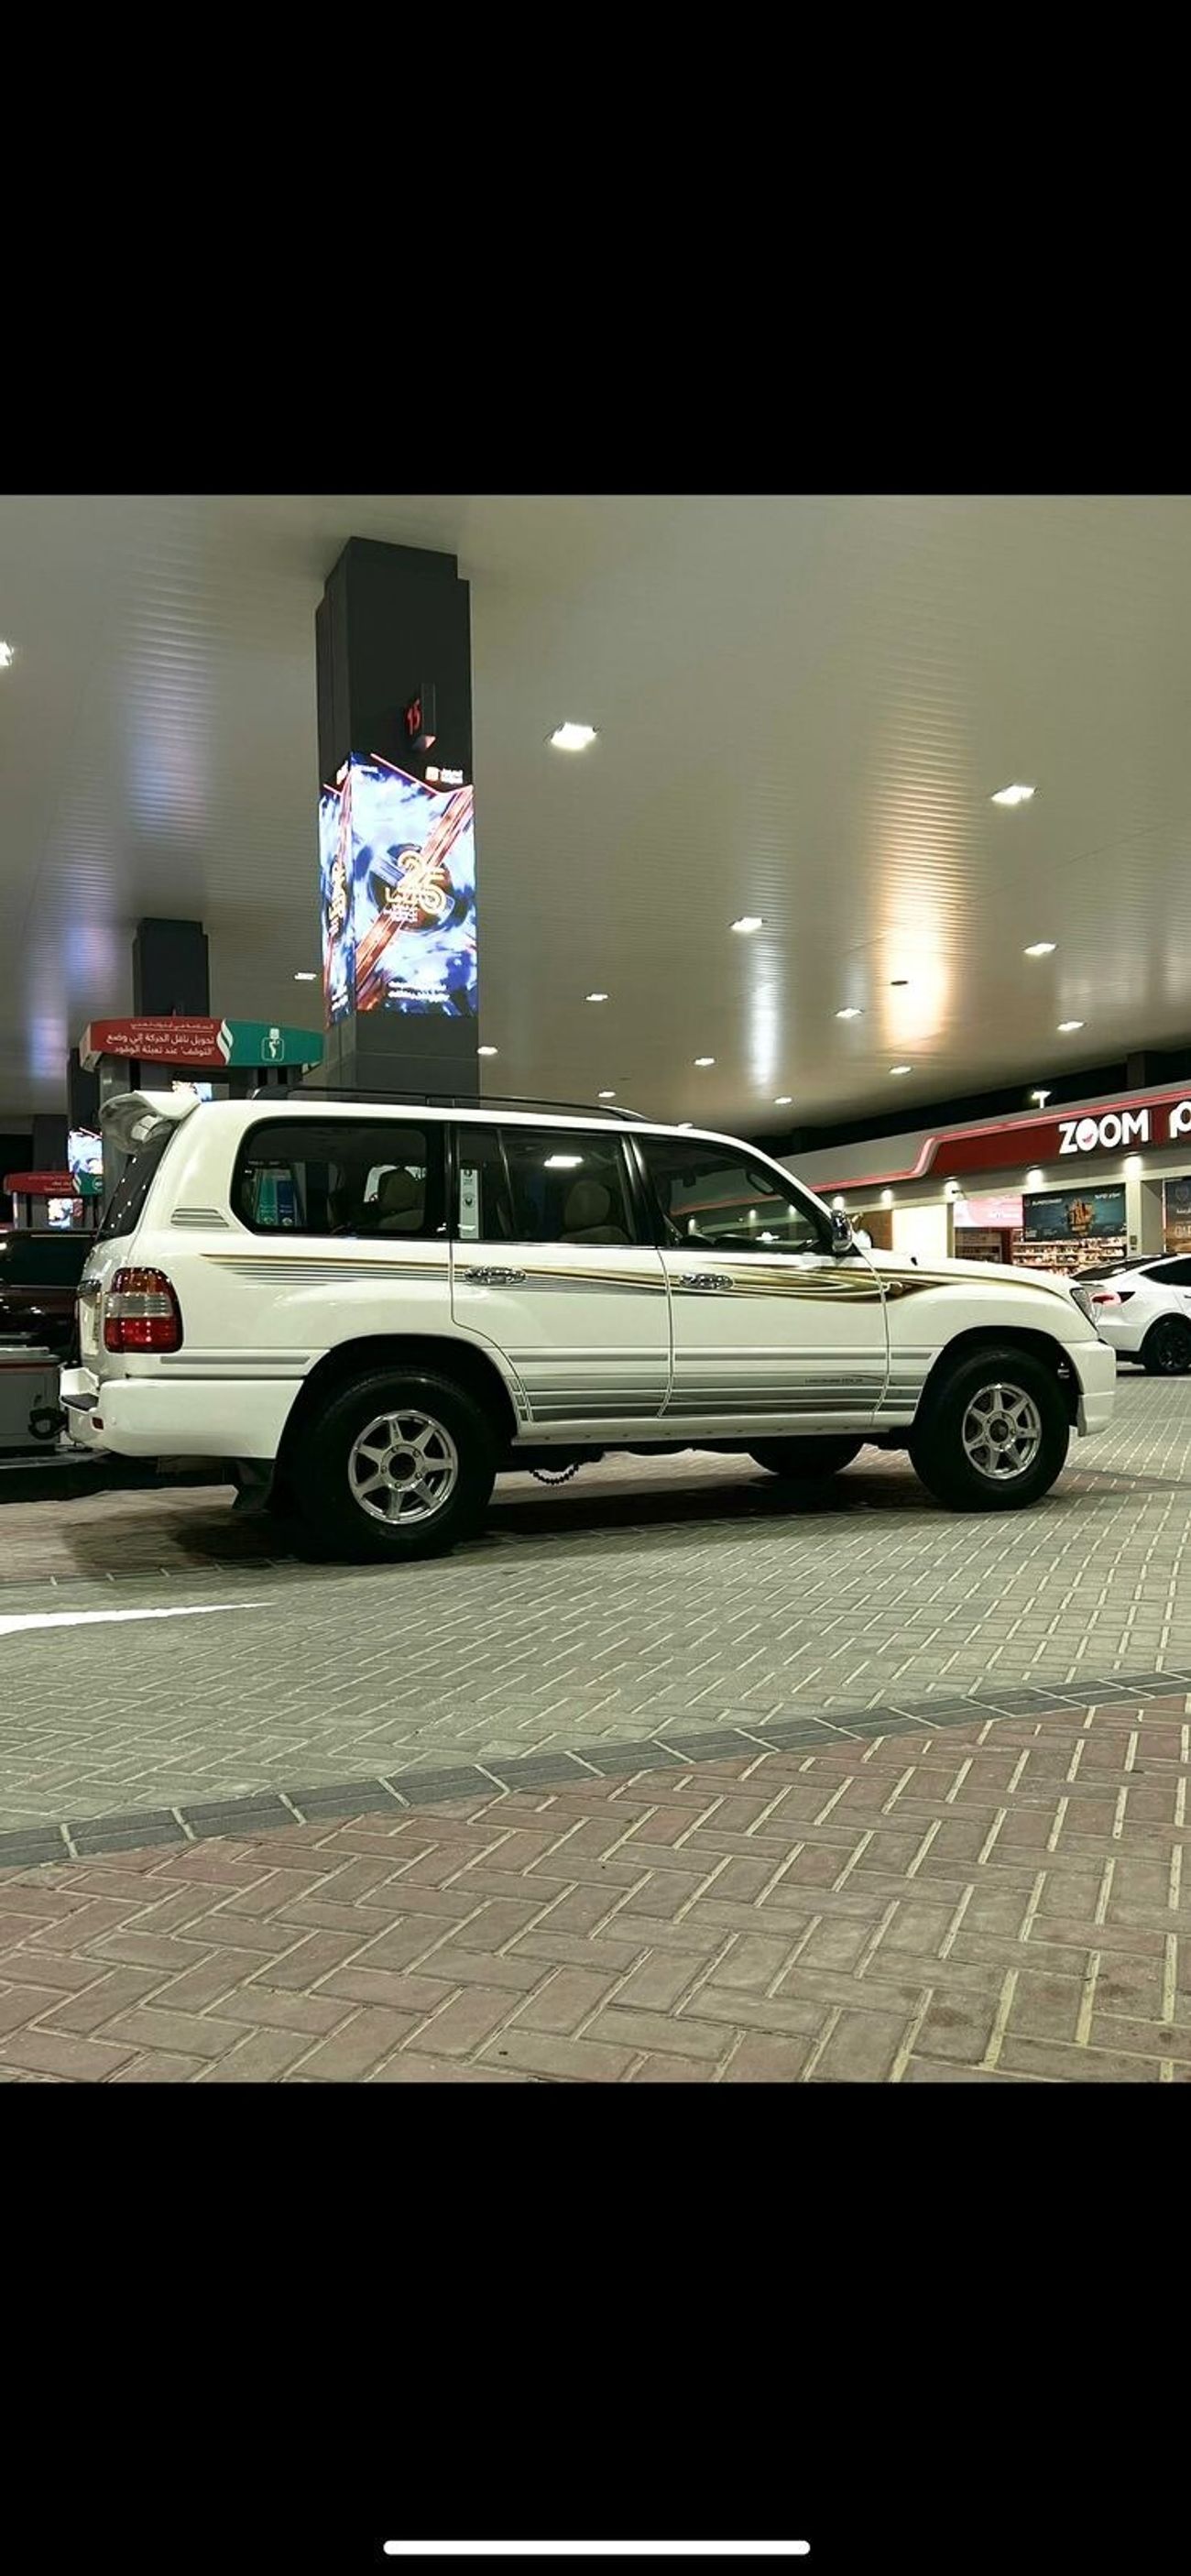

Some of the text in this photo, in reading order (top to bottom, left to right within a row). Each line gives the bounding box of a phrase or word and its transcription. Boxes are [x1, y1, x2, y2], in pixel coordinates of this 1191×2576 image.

[105, 1032, 128, 1045] وضع
[145, 1032, 170, 1044] الحركة
[1059, 1109, 1149, 1154] ZOOM
